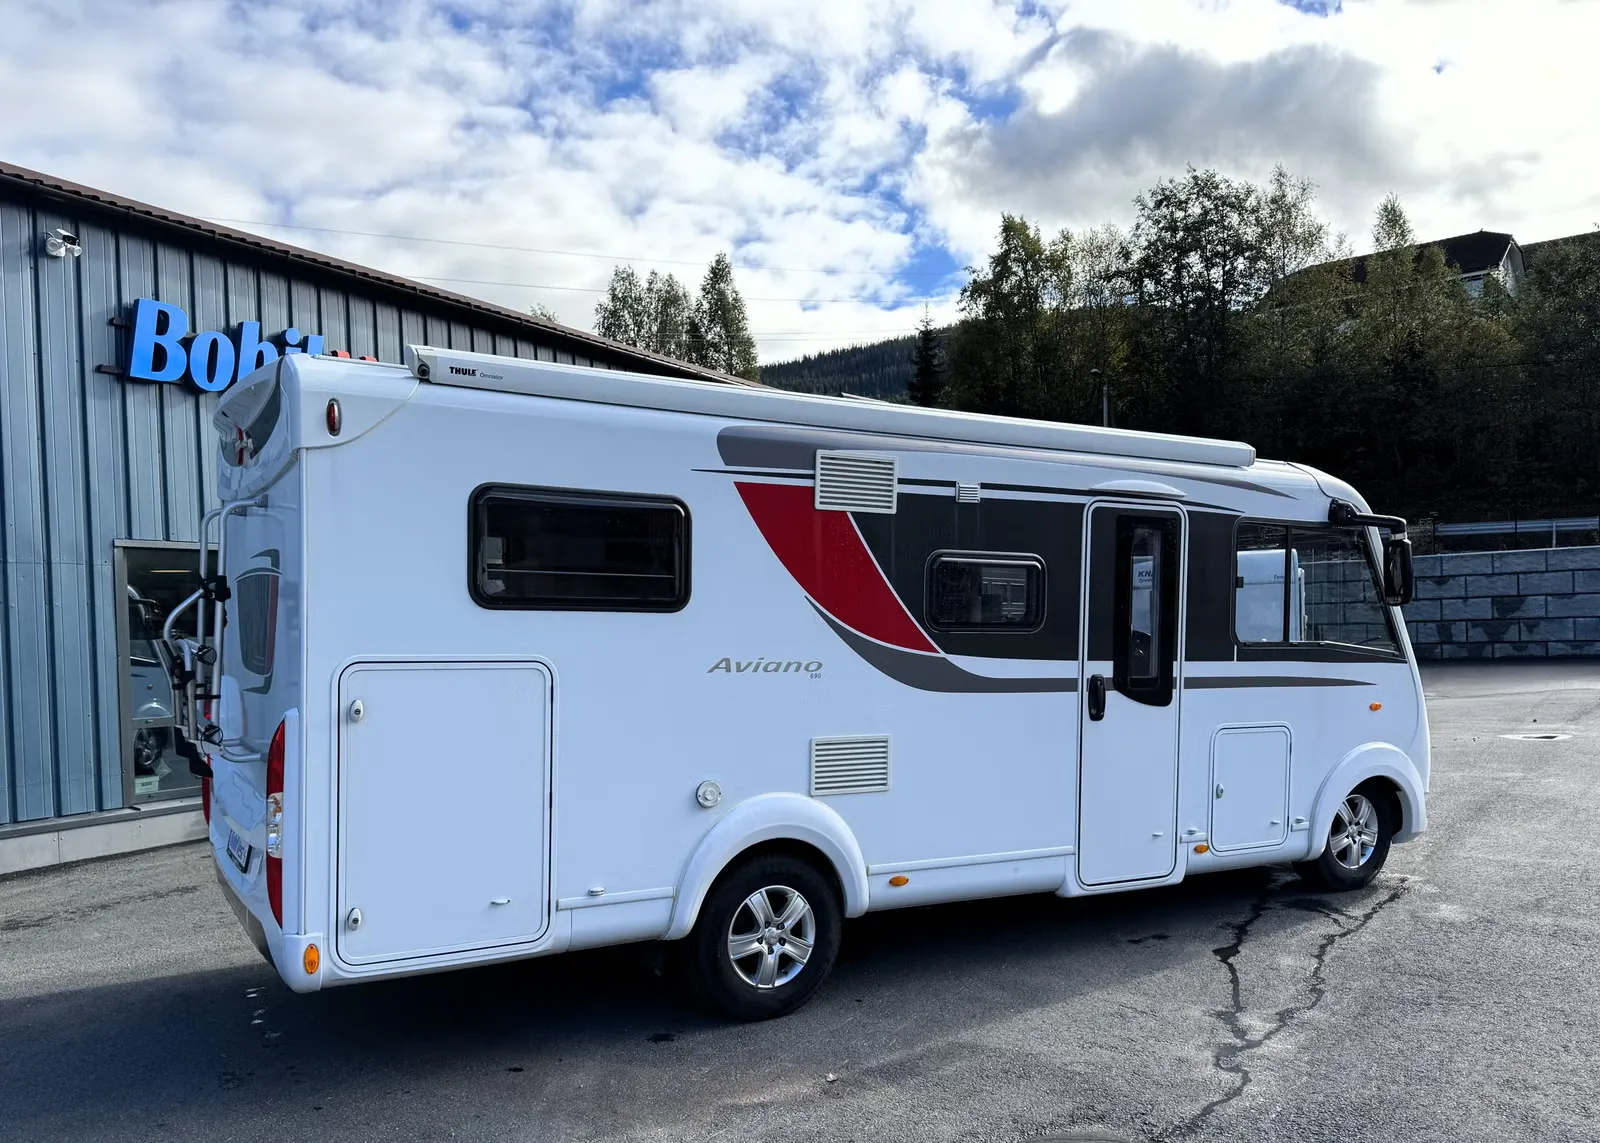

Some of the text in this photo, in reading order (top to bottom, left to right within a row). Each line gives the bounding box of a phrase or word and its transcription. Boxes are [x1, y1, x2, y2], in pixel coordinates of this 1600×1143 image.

[129, 297, 325, 392] Bob
[449, 366, 477, 377] THULE
[707, 657, 823, 673] Aviano
[809, 672, 822, 680] 690
